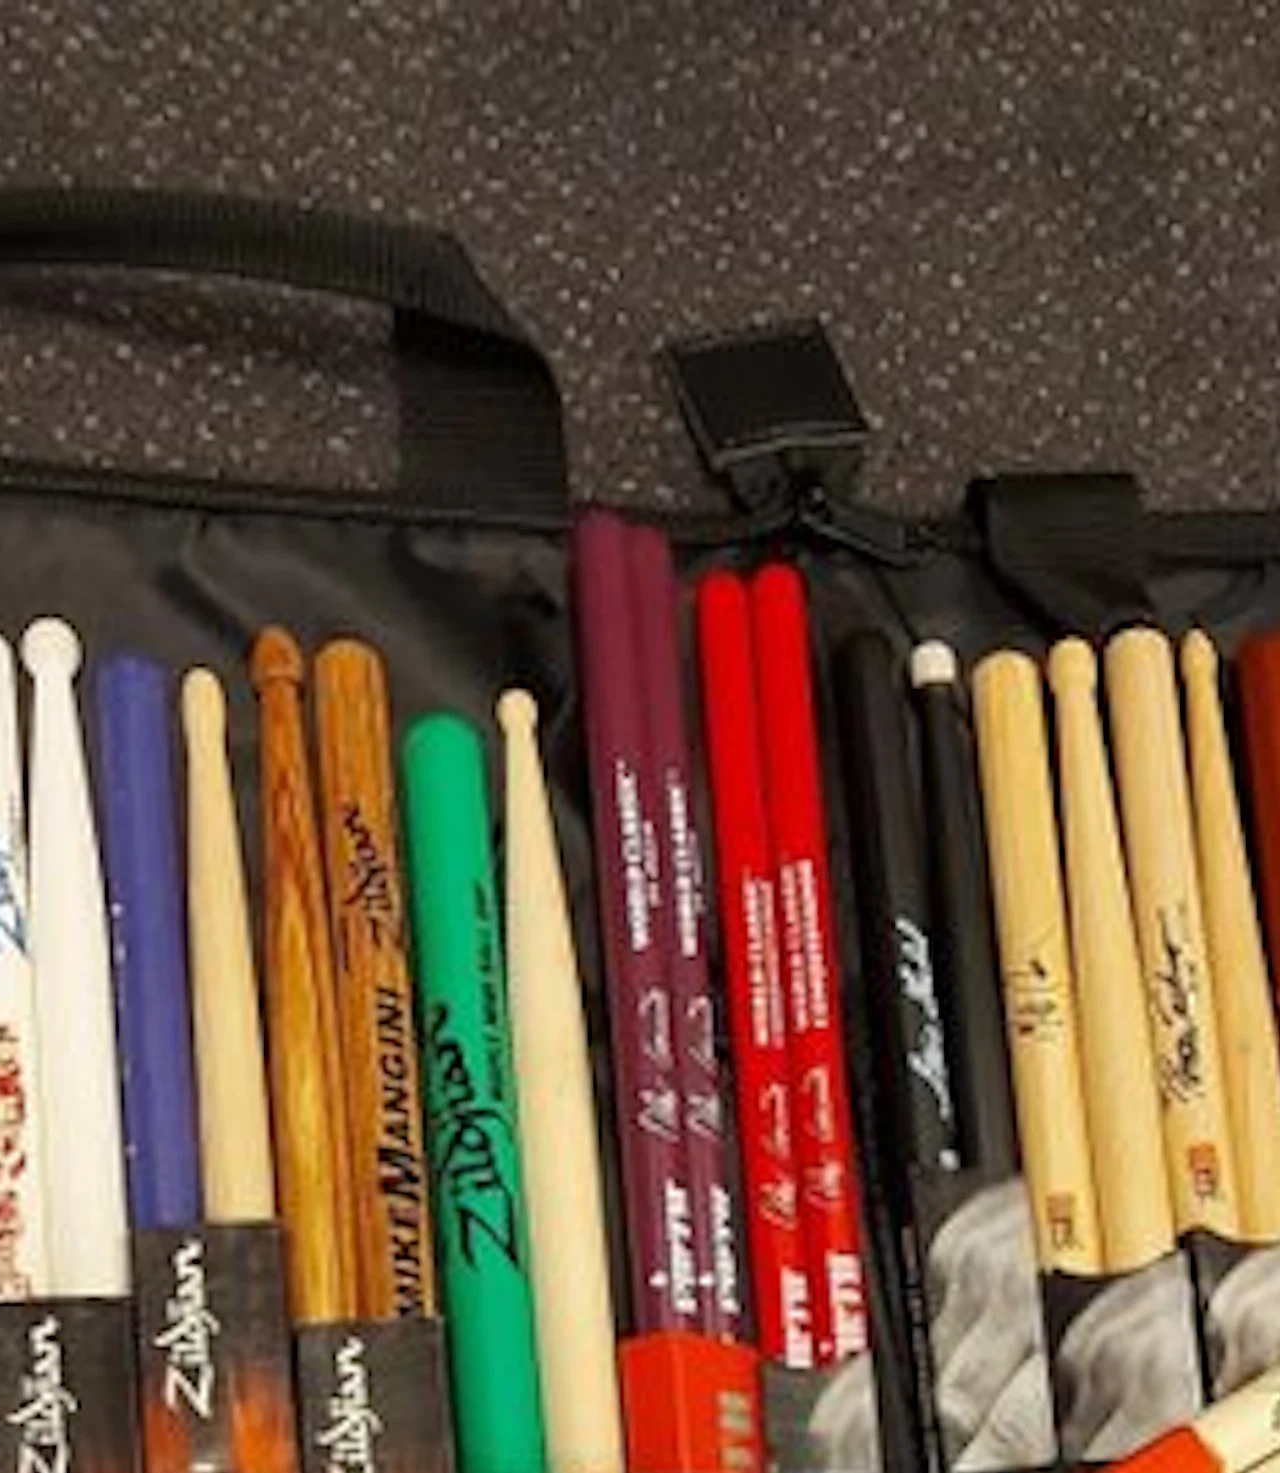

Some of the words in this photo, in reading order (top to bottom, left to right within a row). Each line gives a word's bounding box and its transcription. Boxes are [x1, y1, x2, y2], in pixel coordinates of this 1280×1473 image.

[376, 985, 421, 1198] MANGINI
[428, 1002, 519, 1272] Zildjian
[152, 1239, 220, 1418] Zildjian
